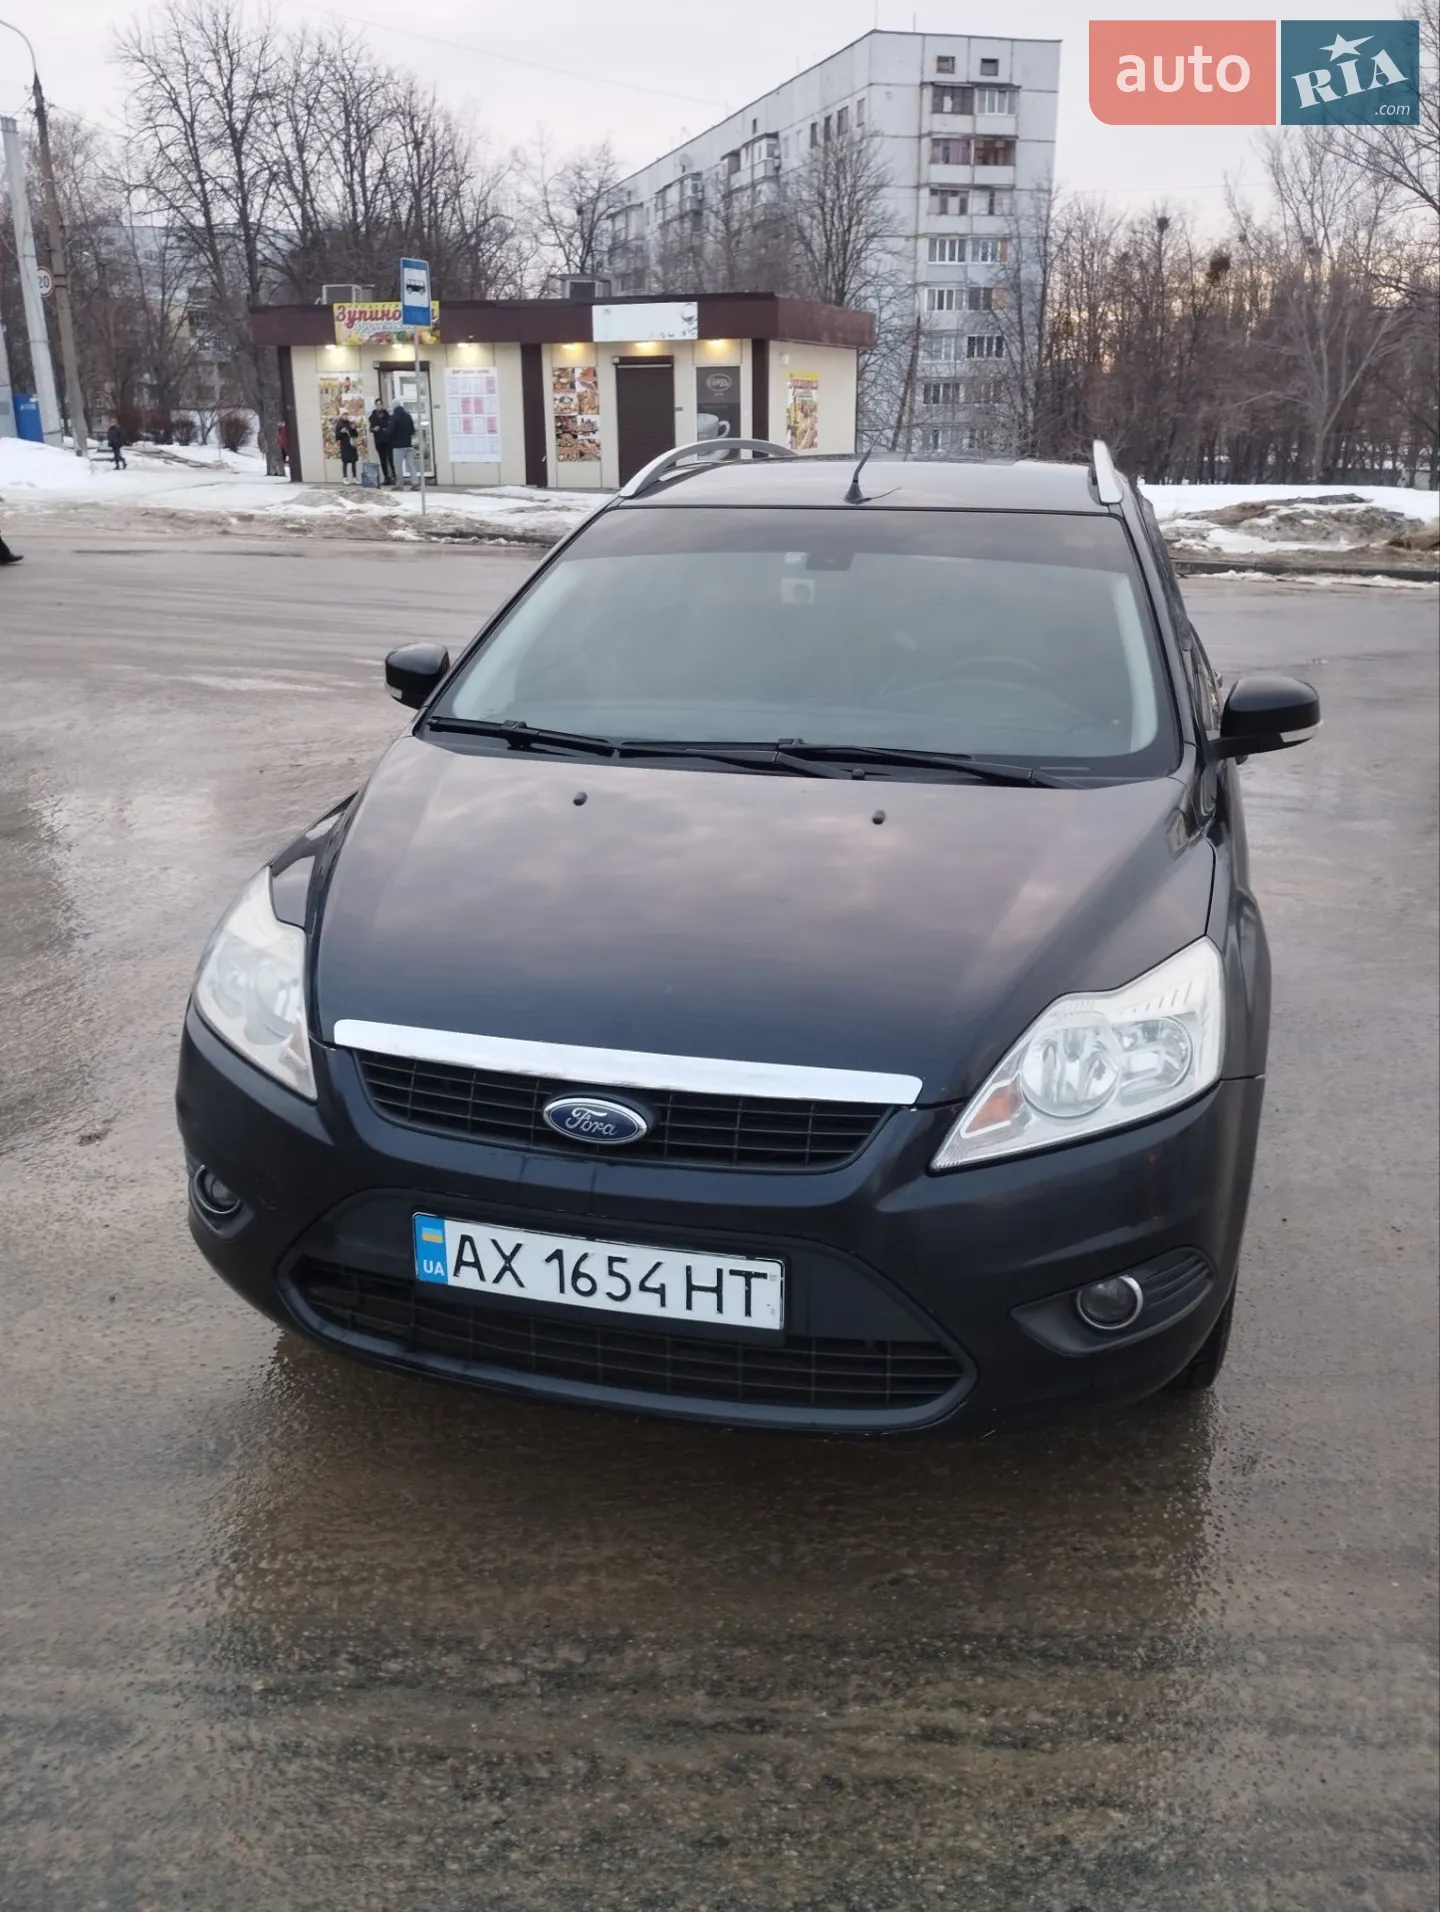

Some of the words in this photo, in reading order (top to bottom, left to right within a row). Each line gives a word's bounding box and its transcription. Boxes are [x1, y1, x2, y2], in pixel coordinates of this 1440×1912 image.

[565, 1107, 618, 1136] Ford
[423, 1259, 445, 1276] UA
[453, 1234, 525, 1288] AX
[544, 1248, 667, 1309] 1654
[685, 1265, 768, 1318] HT
